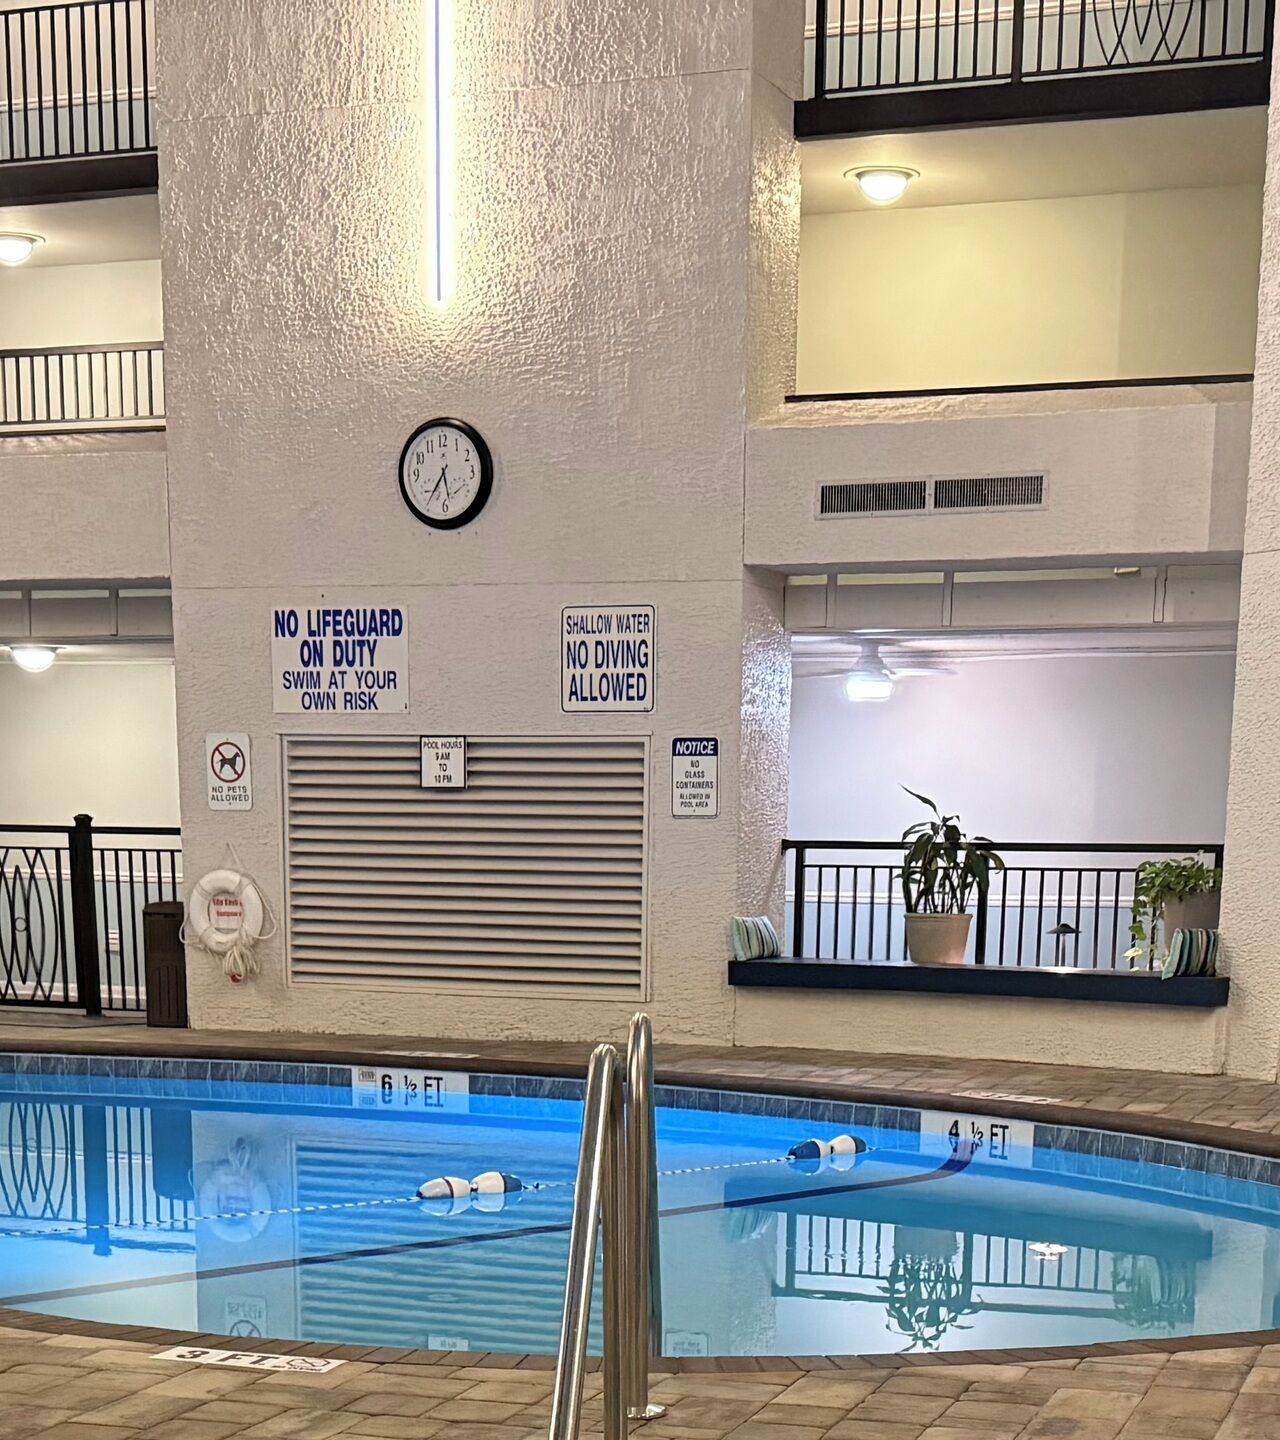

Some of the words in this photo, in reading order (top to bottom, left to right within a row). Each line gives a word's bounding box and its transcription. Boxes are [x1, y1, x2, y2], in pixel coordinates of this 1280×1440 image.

[426, 440, 434, 453] 11
[438, 434, 448, 448] 12
[416, 452, 424, 465] 10
[464, 449, 470, 462] 2
[413, 468, 420, 483] 9
[470, 465, 475, 479] 3
[442, 499, 448, 512] 6
[274, 609, 299, 638] NO
[307, 608, 403, 637] LIFEGUARD
[566, 614, 613, 635] SHALLOW
[616, 613, 650, 634] WATER
[300, 639, 324, 667] ON
[333, 639, 378, 667] DUTY
[566, 640, 588, 670] NO
[595, 639, 649, 669] DIVING
[282, 670, 321, 690] SWIM
[328, 670, 347, 690] AT
[355, 670, 397, 690] YOUR
[568, 672, 647, 702] ALLOWED
[301, 691, 336, 711] OWN
[344, 691, 378, 711] RISK
[423, 740, 440, 750] POOL
[675, 740, 716, 755] NOTICE
[438, 763, 448, 772] TO
[690, 759, 700, 768] NO
[684, 770, 705, 779] GLASS
[211, 785, 224, 794] NO
[227, 785, 247, 794] PETS
[675, 781, 714, 789] CONTAINERS
[210, 794, 250, 802] ALLOWED
[424, 1076, 444, 1092] FT
[948, 1120, 960, 1137] 4
[990, 1124, 1009, 1142] FT
[176, 1350, 210, 1359] 3
